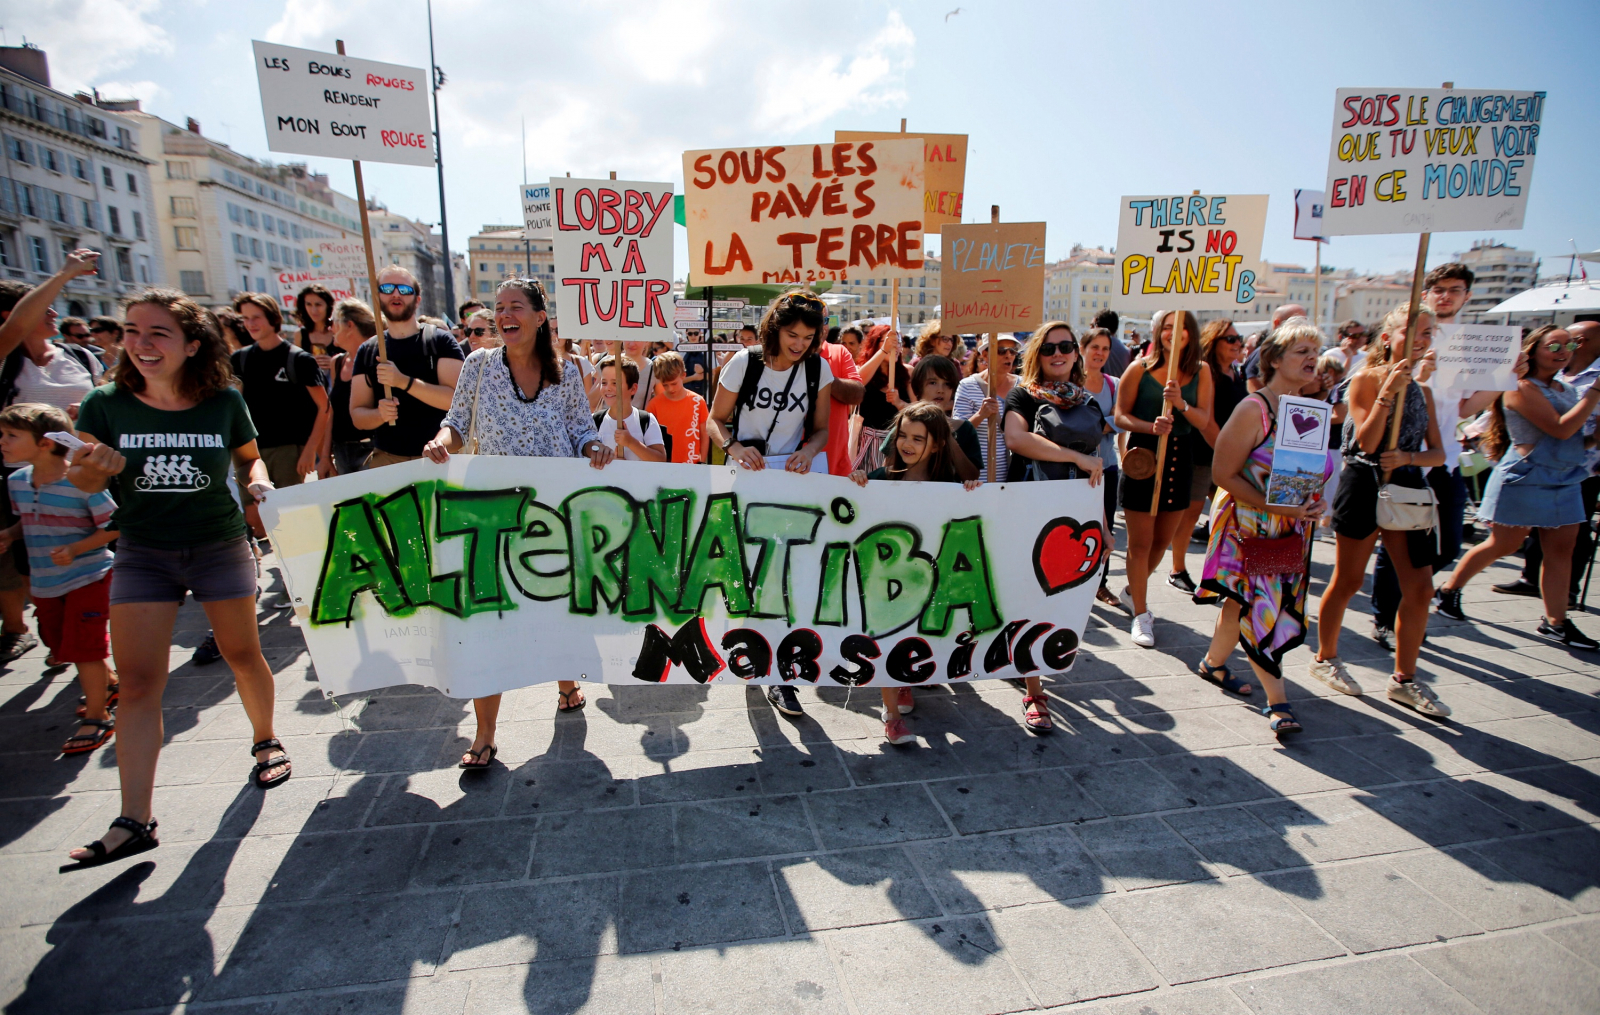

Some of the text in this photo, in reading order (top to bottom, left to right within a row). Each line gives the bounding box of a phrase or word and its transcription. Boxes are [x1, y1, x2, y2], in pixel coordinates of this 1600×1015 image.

[264, 57, 415, 91] LES BOUES ROUGES
[324, 89, 381, 109] RENDENT
[1342, 91, 1547, 128] SOIS LE CHANGEMENT
[277, 116, 427, 149] MON BOUT ROUGE
[1338, 123, 1540, 163] QUE TU VEUX VOIR
[693, 142, 877, 189] SOUS LES
[1331, 158, 1525, 208] EN CE MONDE
[525, 187, 550, 199] NOTR
[751, 177, 875, 223] PAVÉS
[555, 188, 673, 238] LOBBY
[1130, 196, 1226, 228] THERE
[580, 236, 646, 274] M'A
[704, 221, 924, 275] LA TERRE
[952, 238, 1045, 273] PLANETE
[1157, 229, 1237, 255] IS NO
[762, 269, 847, 283] MAI 2018
[1122, 254, 1256, 303] PLANET B
[562, 278, 671, 328] TUER
[1439, 355, 1512, 364] POUVONS CONTINUER
[1448, 344, 1473, 352] CROIRE
[119, 433, 224, 448] ALTERNATIBA
